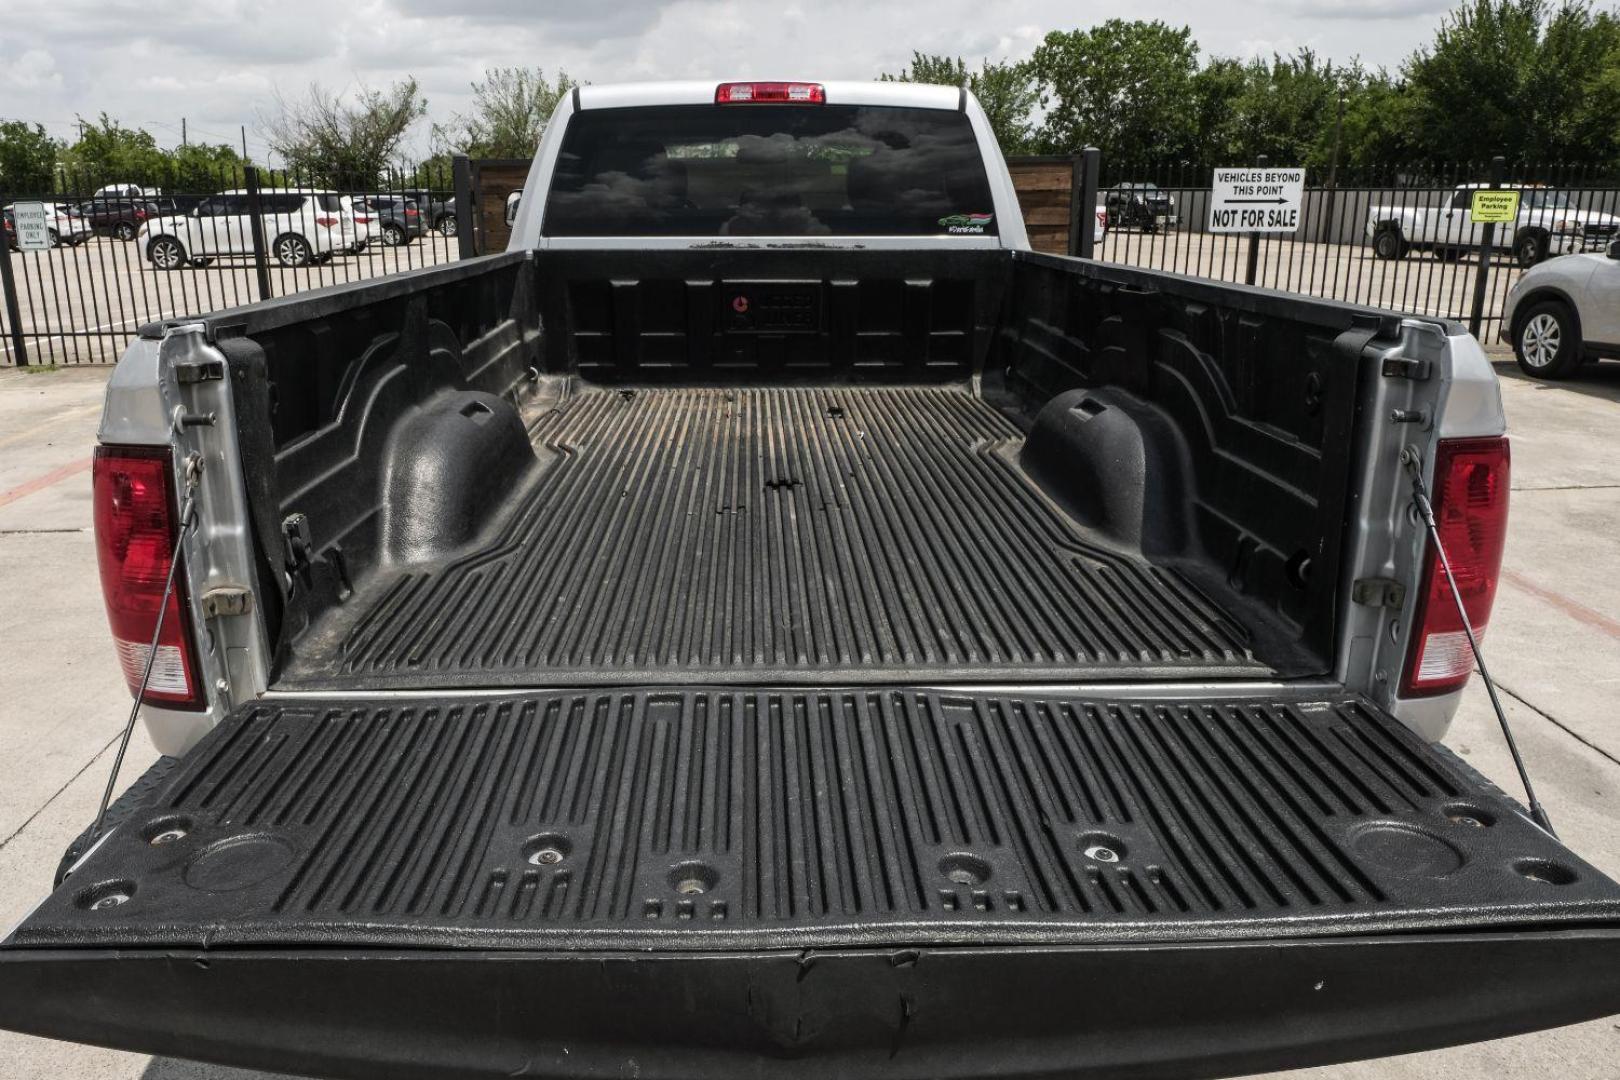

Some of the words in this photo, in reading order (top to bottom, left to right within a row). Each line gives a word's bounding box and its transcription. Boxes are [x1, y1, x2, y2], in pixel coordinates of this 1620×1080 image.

[1218, 172, 1262, 183] VEHICLES
[1265, 172, 1300, 183] BEYOND
[1233, 185, 1254, 195] THIS
[1256, 185, 1284, 195] POINT
[1478, 195, 1512, 203] Employee
[1212, 209, 1238, 227] NOT
[1240, 209, 1265, 227] FOR
[1267, 209, 1297, 227] SALE
